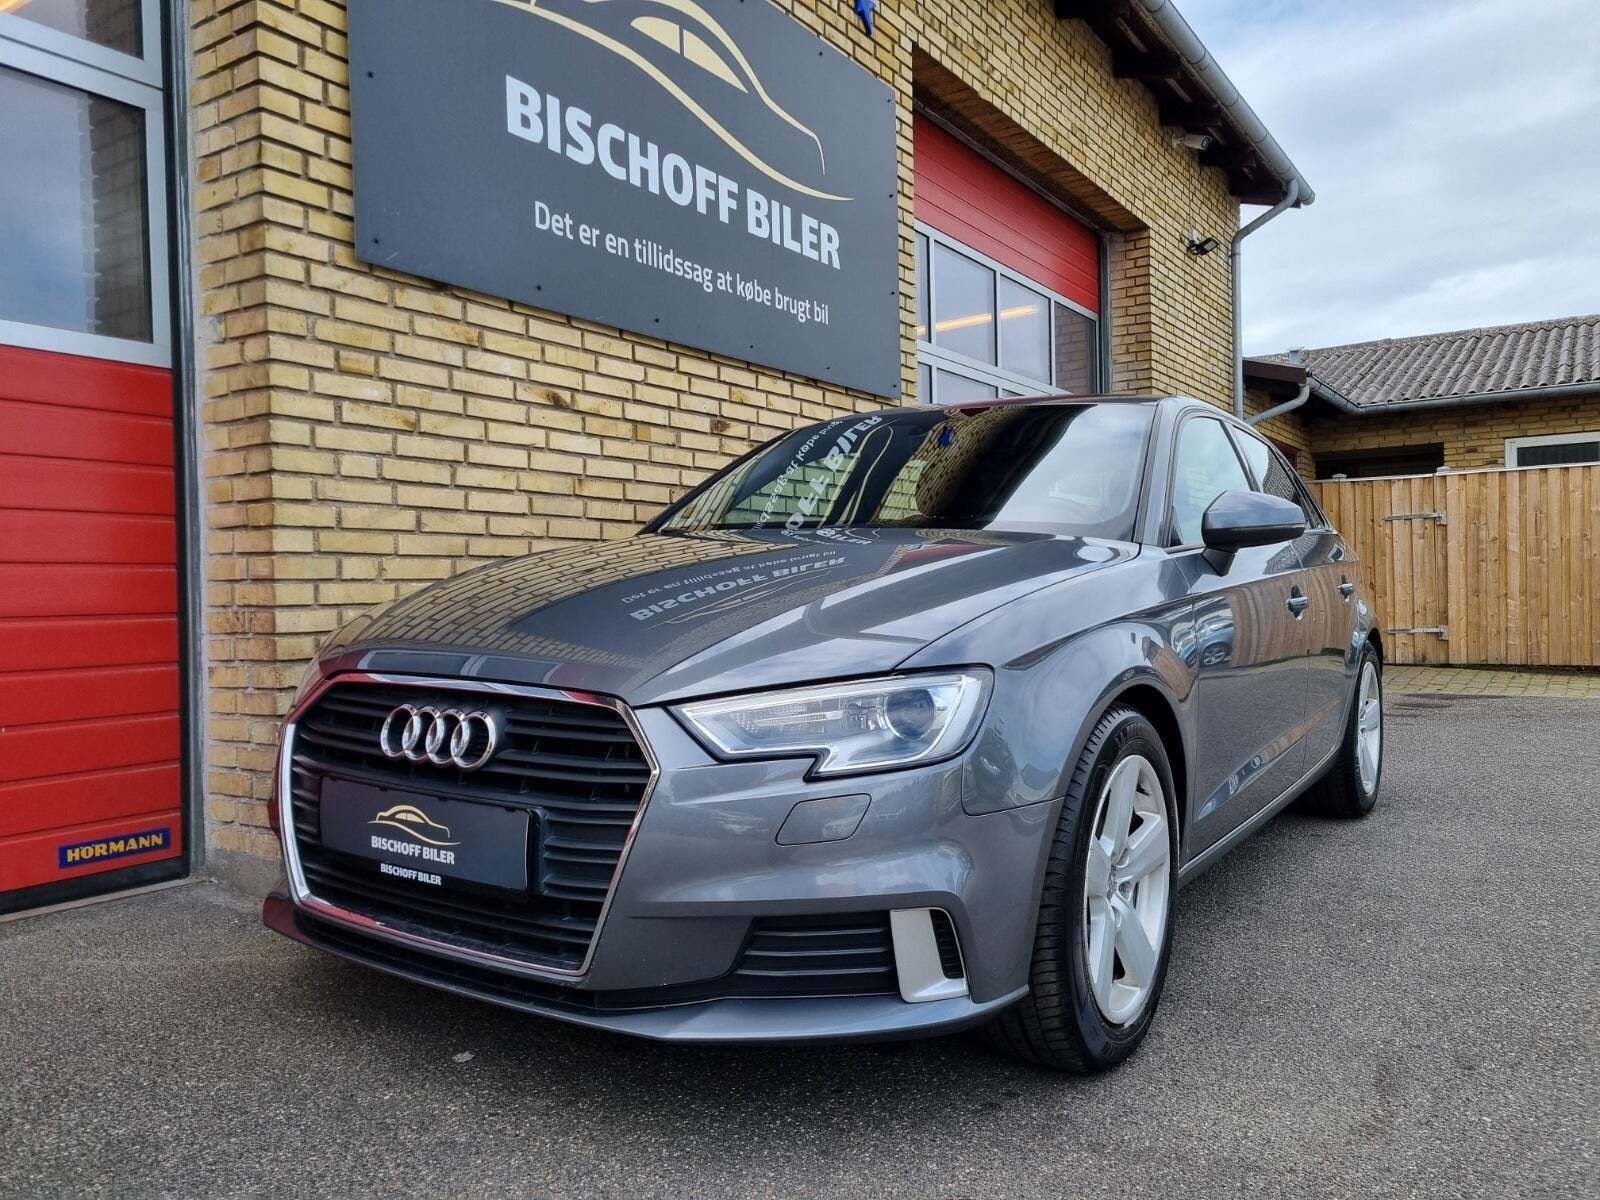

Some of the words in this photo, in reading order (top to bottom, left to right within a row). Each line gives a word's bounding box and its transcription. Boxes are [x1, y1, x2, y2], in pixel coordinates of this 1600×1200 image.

[506, 74, 738, 224] BISCHOFF
[747, 188, 841, 270] BILER
[535, 200, 574, 240] Det
[579, 222, 600, 247] er
[605, 232, 629, 258] en
[634, 237, 713, 292] tillidssag
[717, 271, 733, 294] at
[736, 273, 771, 306] købe
[775, 287, 811, 323] brugt
[813, 301, 829, 325] bil
[371, 835, 422, 857] BISCHOFF
[422, 846, 455, 865] BILER
[380, 863, 417, 880] BISCHOFF
[418, 872, 442, 886] BILER
